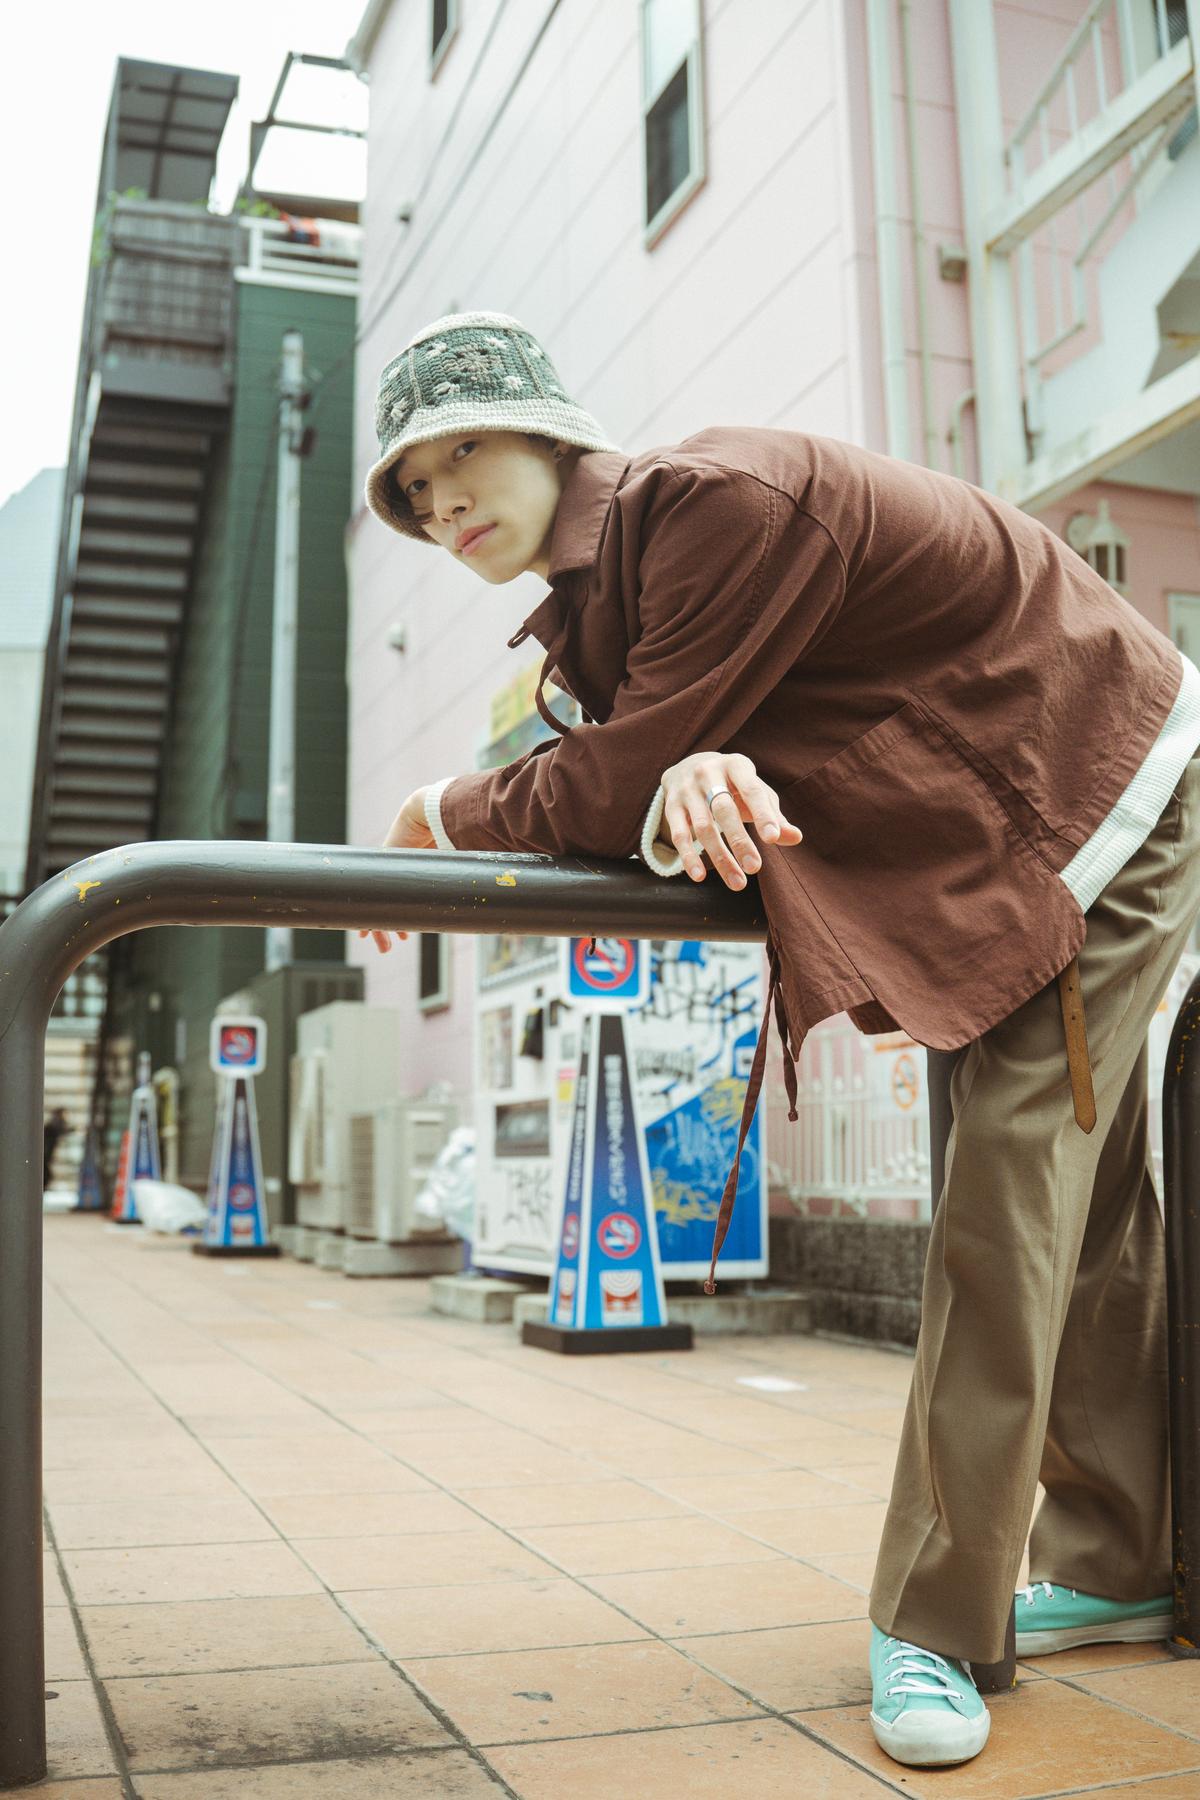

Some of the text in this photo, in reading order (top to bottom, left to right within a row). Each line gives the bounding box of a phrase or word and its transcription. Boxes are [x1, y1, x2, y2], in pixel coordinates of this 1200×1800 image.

[603, 1053, 628, 1206] えください。
